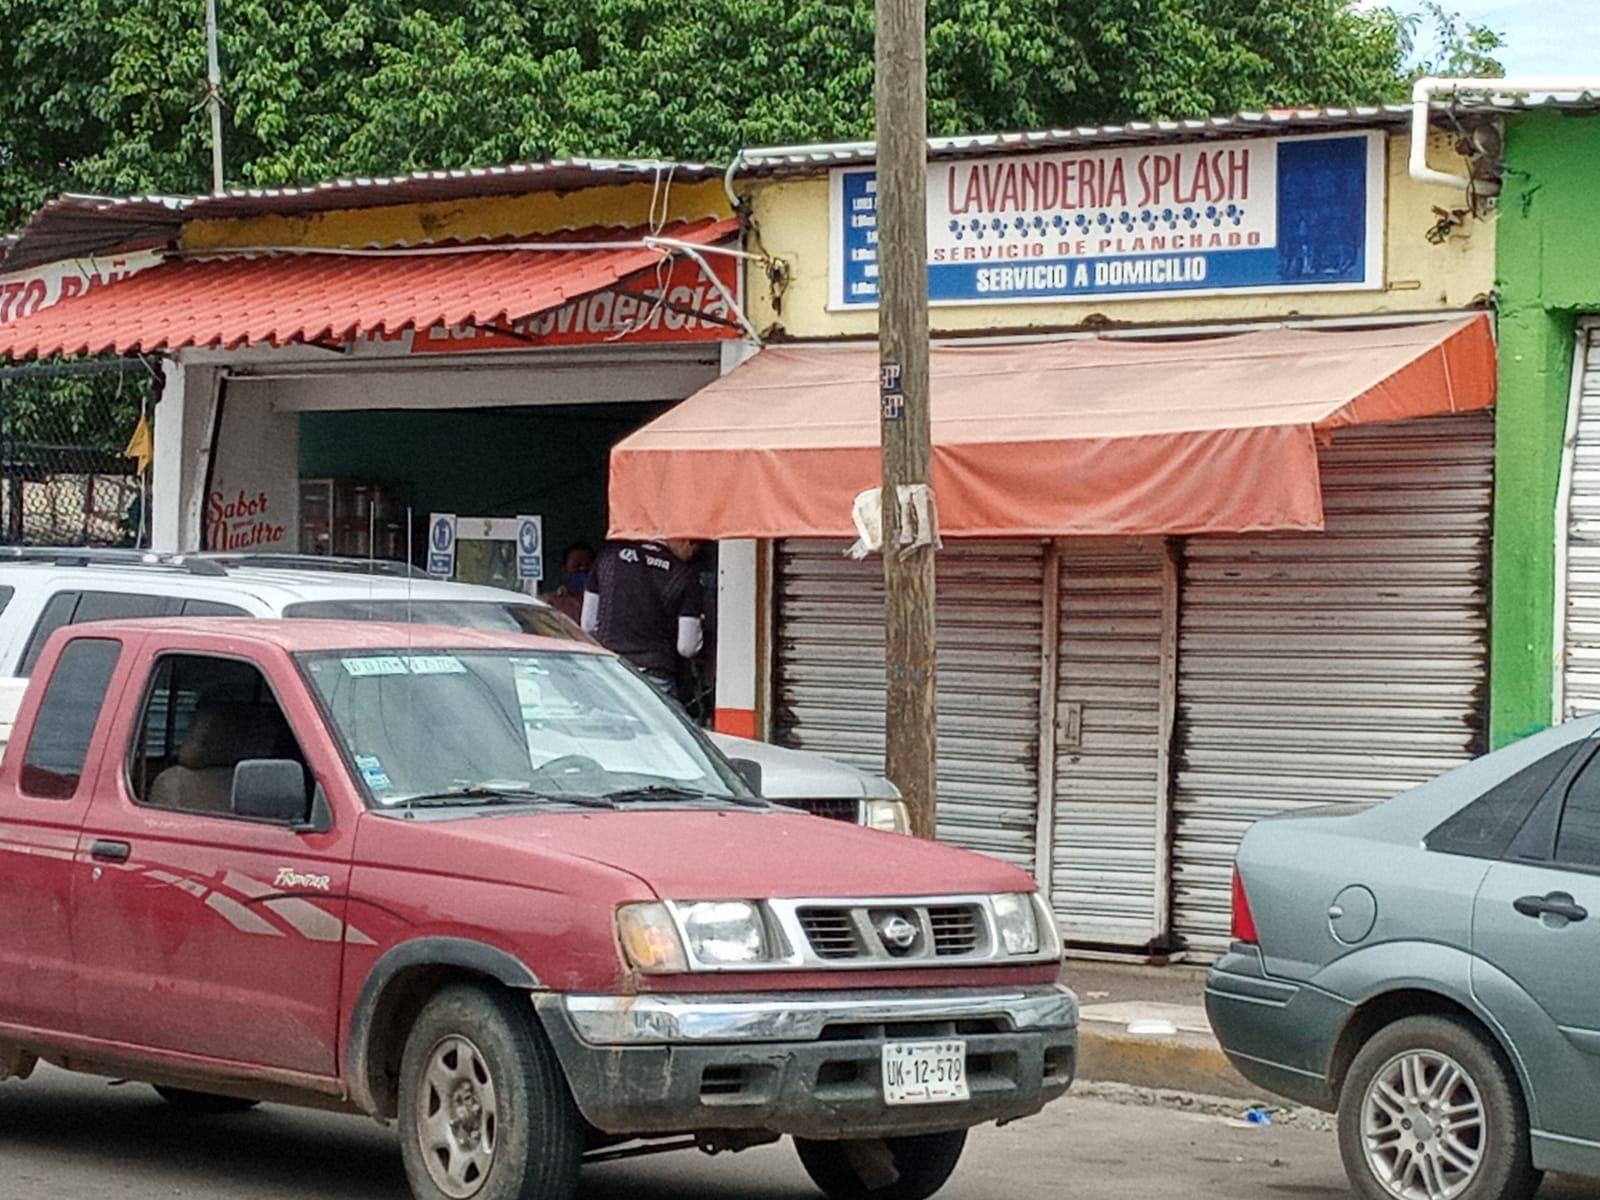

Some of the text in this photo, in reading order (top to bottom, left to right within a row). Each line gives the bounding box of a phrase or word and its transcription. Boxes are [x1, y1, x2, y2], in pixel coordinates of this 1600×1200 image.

[948, 149, 1249, 215] LAVANDERIA SPLASH
[934, 231, 1261, 261] SERVICIO DE PLANCHADO
[976, 256, 1207, 292] SERVICIO A DOMICILIO
[887, 1058, 962, 1087] UK-12-579
